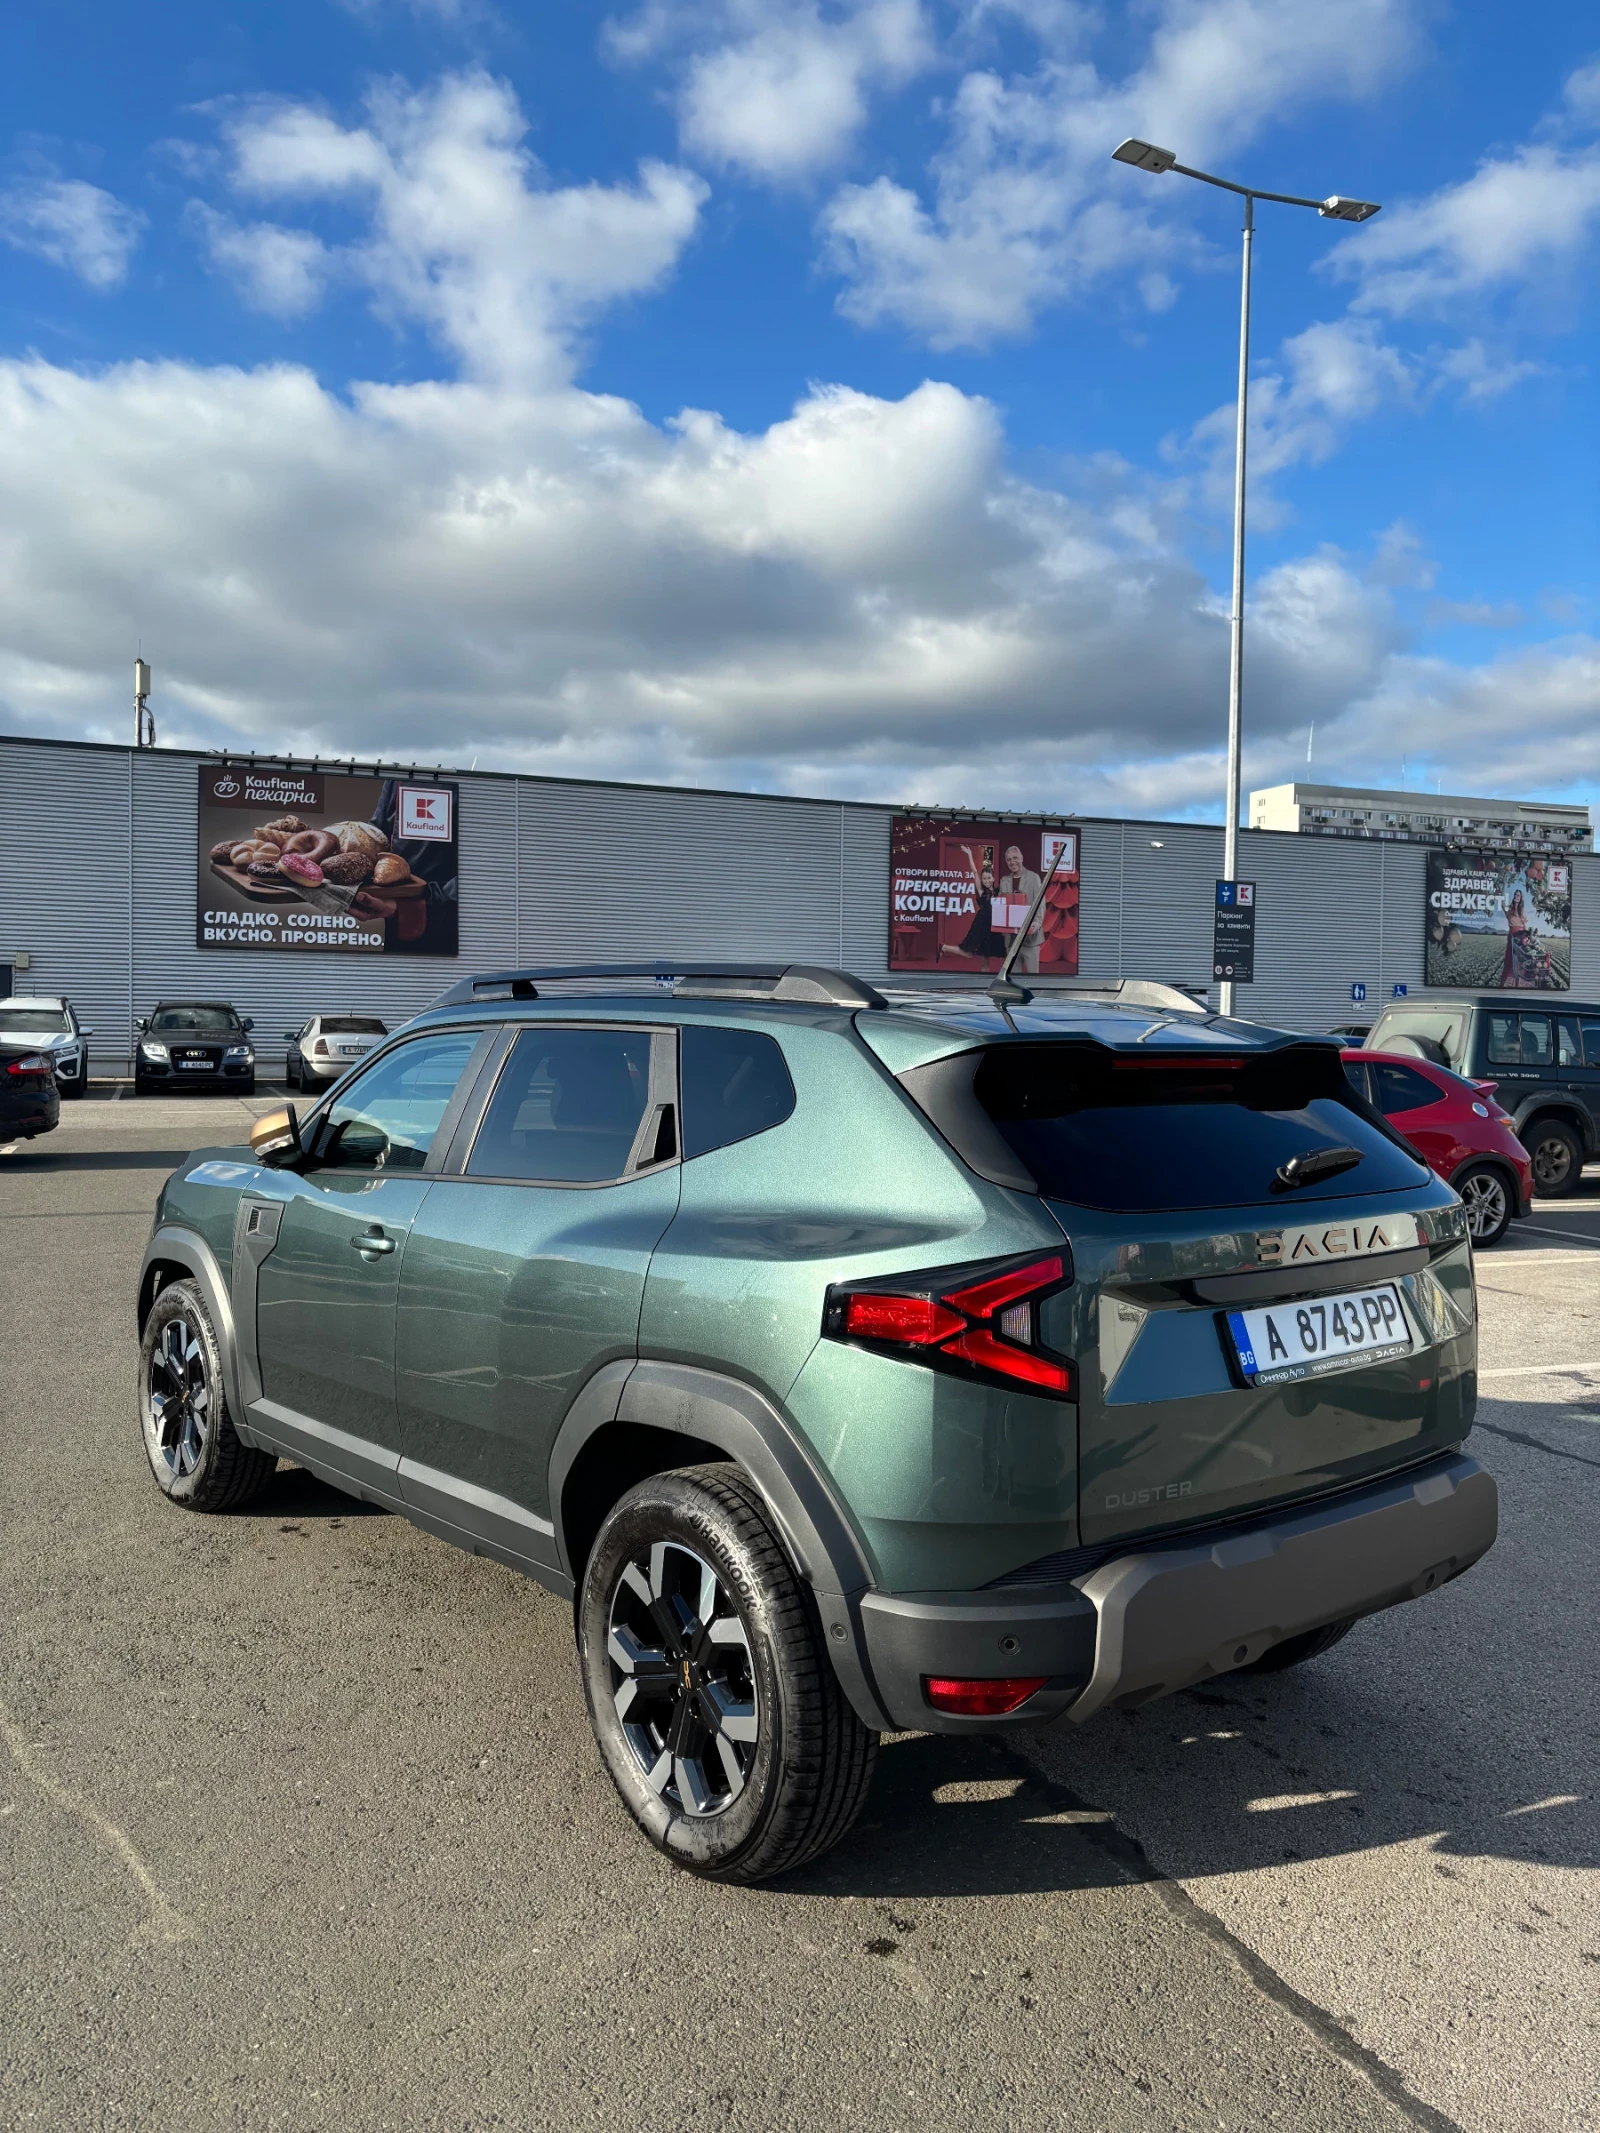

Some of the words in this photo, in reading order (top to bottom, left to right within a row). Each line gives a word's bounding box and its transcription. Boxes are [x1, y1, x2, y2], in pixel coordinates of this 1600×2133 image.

[245, 775, 305, 790] Kaufland
[244, 788, 318, 806] пекарна
[406, 822, 445, 832] Kaufland
[895, 868, 928, 877] ОТВОРИ
[930, 869, 963, 878] ВРАТАТА
[894, 880, 976, 894] ПРЕКРАСНА
[1444, 877, 1496, 892] ЗДРАВЕЙ,
[894, 895, 976, 916] КОЛЕДА
[1430, 892, 1510, 912] СВЕЖЕСТ!
[204, 911, 282, 927] СЛАДКО.
[287, 914, 360, 930] СОЛЕНО.
[900, 914, 934, 923] Kaufland
[204, 928, 276, 942] ВКУСНО.
[281, 930, 385, 946] ПРОВЕРЕНО.
[1256, 1225, 1390, 1262] DACIA
[1265, 1314, 1288, 1361] A
[1239, 1352, 1255, 1366] BG
[1376, 1347, 1405, 1358] DACIA
[1106, 1480, 1192, 1508] DUSTER
